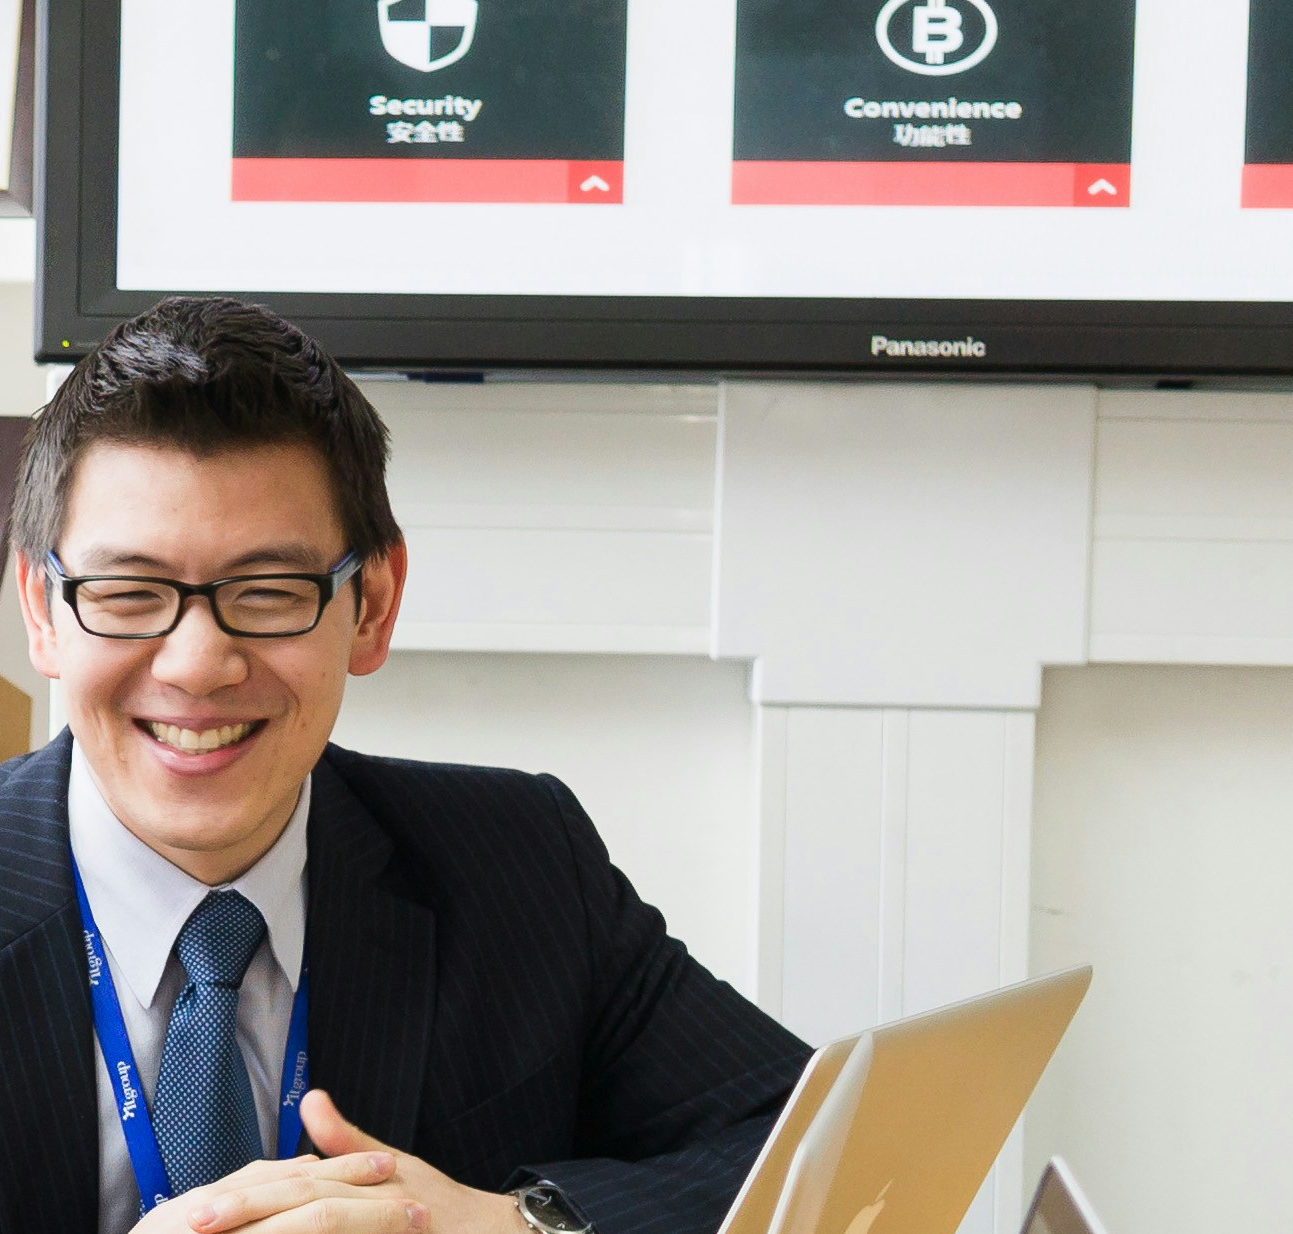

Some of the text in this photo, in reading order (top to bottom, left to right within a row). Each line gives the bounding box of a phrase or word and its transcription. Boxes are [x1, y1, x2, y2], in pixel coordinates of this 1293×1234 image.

[369, 94, 483, 122] Security
[843, 96, 1023, 120] Convenience
[386, 120, 465, 144] 安全性
[870, 335, 987, 357] Panasonic
